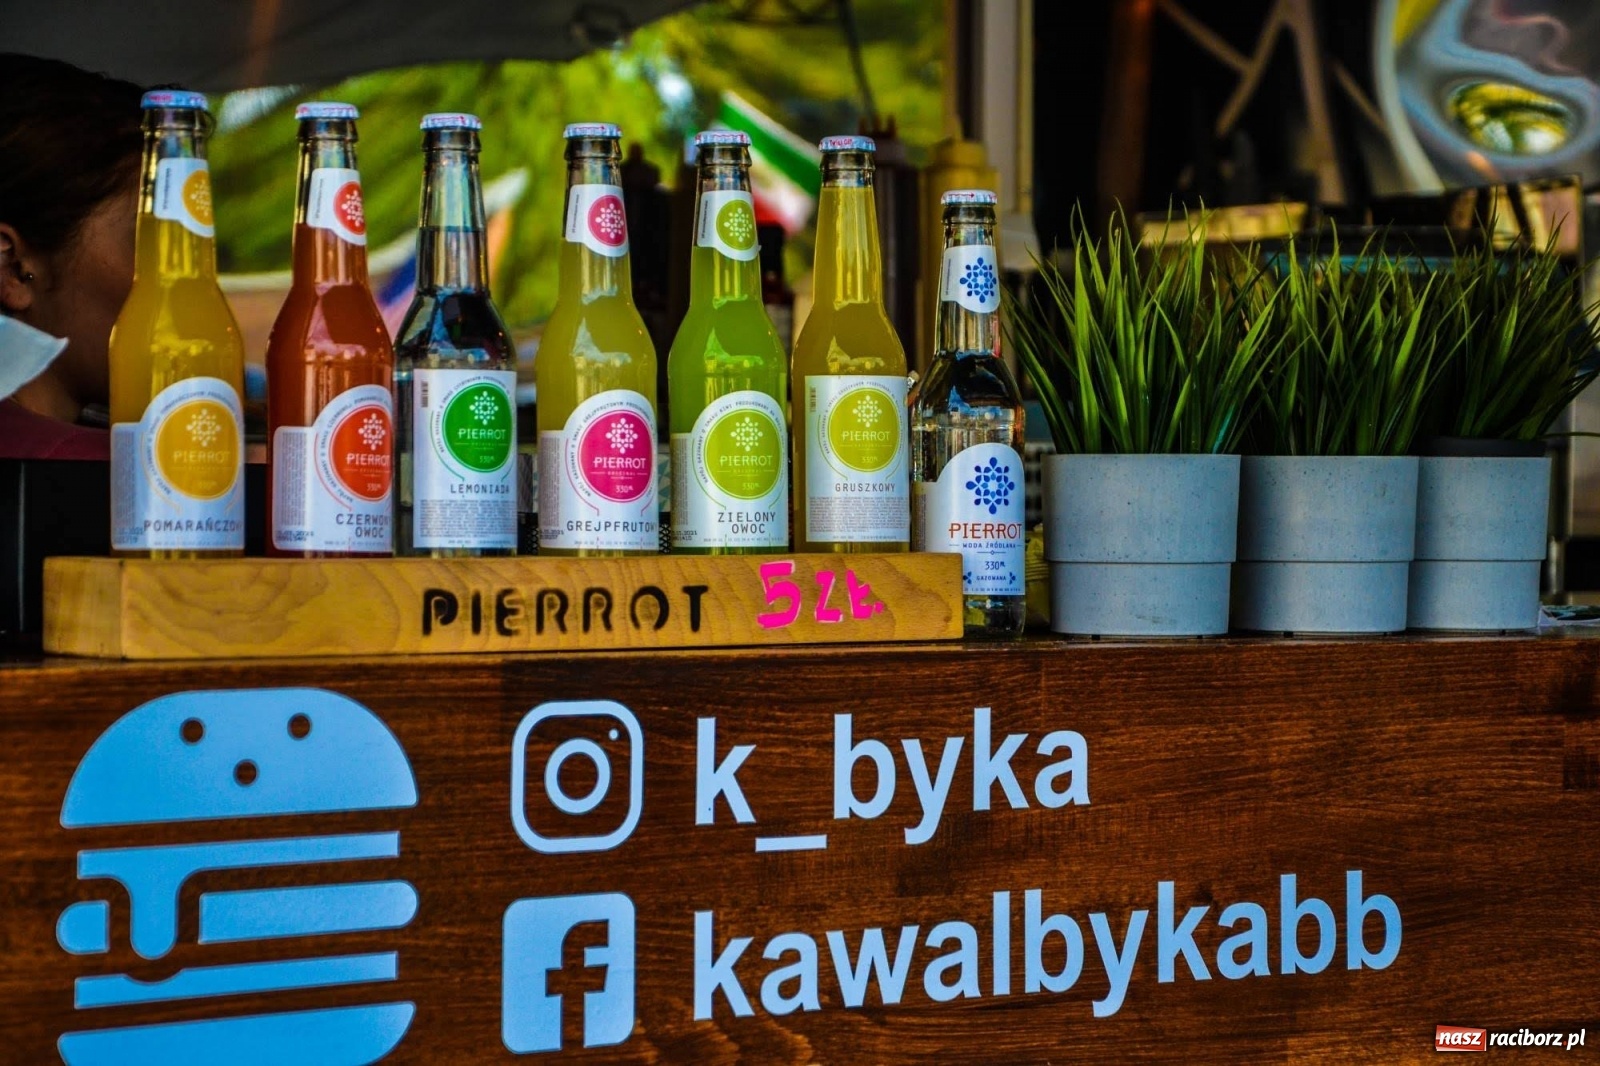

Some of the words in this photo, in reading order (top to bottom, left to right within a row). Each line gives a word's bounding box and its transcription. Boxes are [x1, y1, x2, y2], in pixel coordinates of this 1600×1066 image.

[457, 428, 506, 440] PIERROT
[841, 431, 891, 441] PIERROT
[173, 450, 230, 464] PIERROT
[593, 457, 646, 469] PIERROT
[720, 455, 773, 467] PIERROT
[450, 484, 510, 494] LEMONIADA
[835, 482, 896, 492] GRUSZKOWY
[717, 511, 776, 523] ZIELONY
[355, 526, 384, 538] OWOC
[731, 523, 766, 534] OWOC
[948, 523, 1022, 540] PIERROT
[757, 560, 803, 630] 5
[422, 585, 709, 637] PIERROT
[696, 707, 1090, 852] k_byka
[694, 870, 1403, 1019] kawalbykabb
